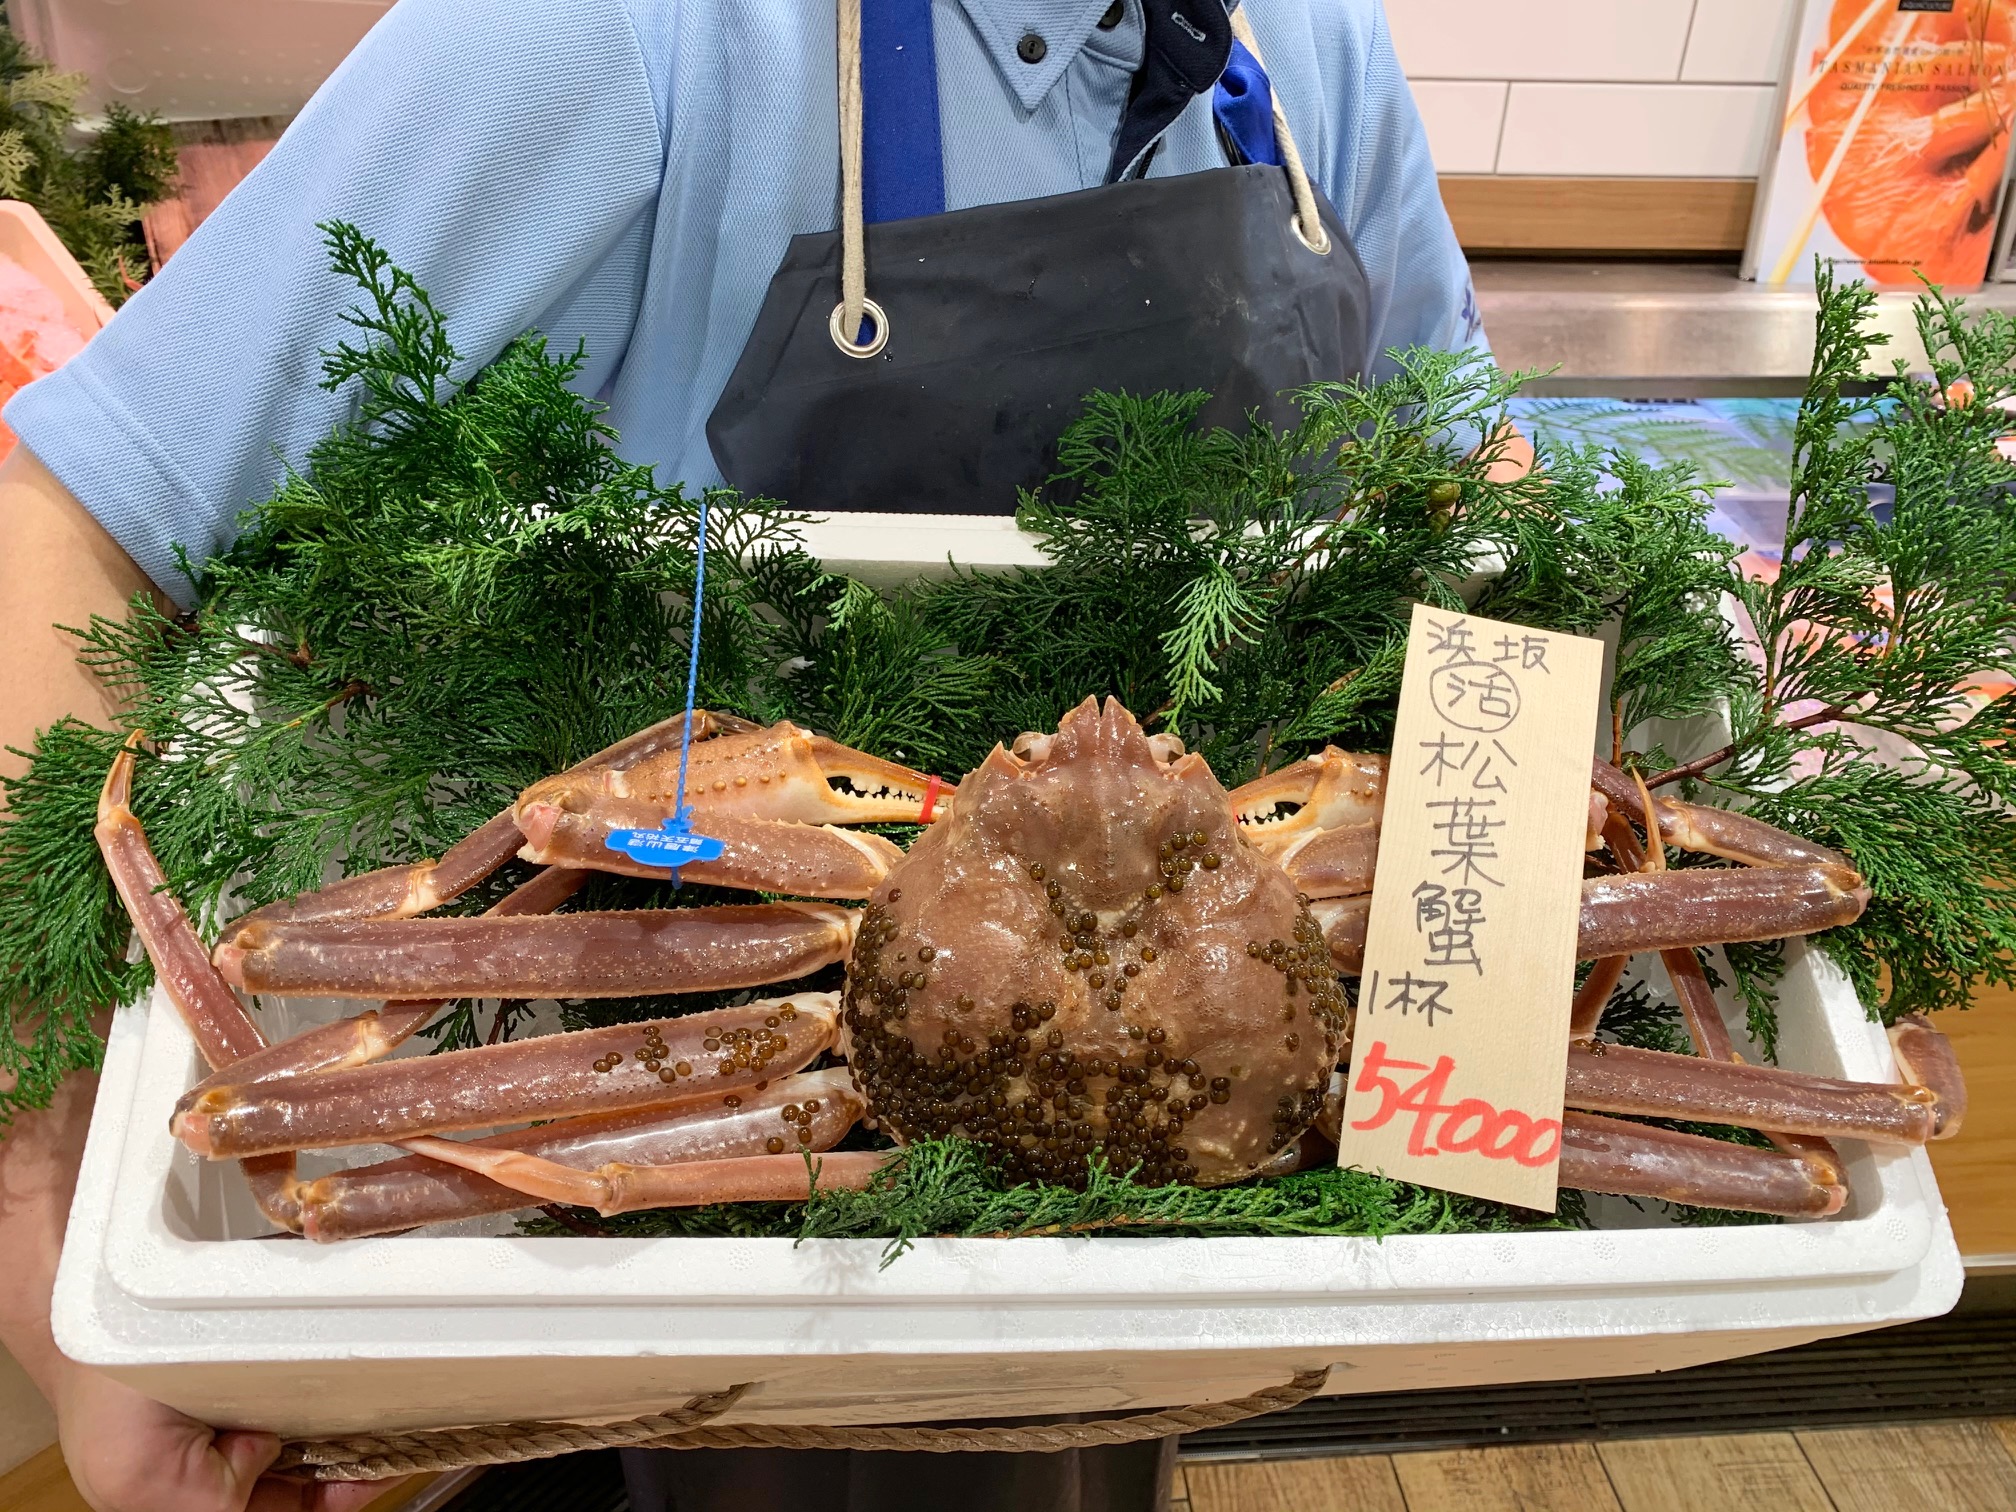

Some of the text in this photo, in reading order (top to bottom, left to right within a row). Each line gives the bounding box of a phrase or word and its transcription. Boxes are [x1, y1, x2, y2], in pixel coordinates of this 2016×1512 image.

[1818, 60, 2006, 77] TASMANIAN SALMON
[1840, 83, 1971, 93] QUALITY FRESHNESS PASSION
[1427, 618, 1550, 674] 浜坂
[1443, 667, 1514, 722] 活
[1412, 731, 1517, 976] 松葉蟹
[1369, 970, 1453, 1027] 1杯
